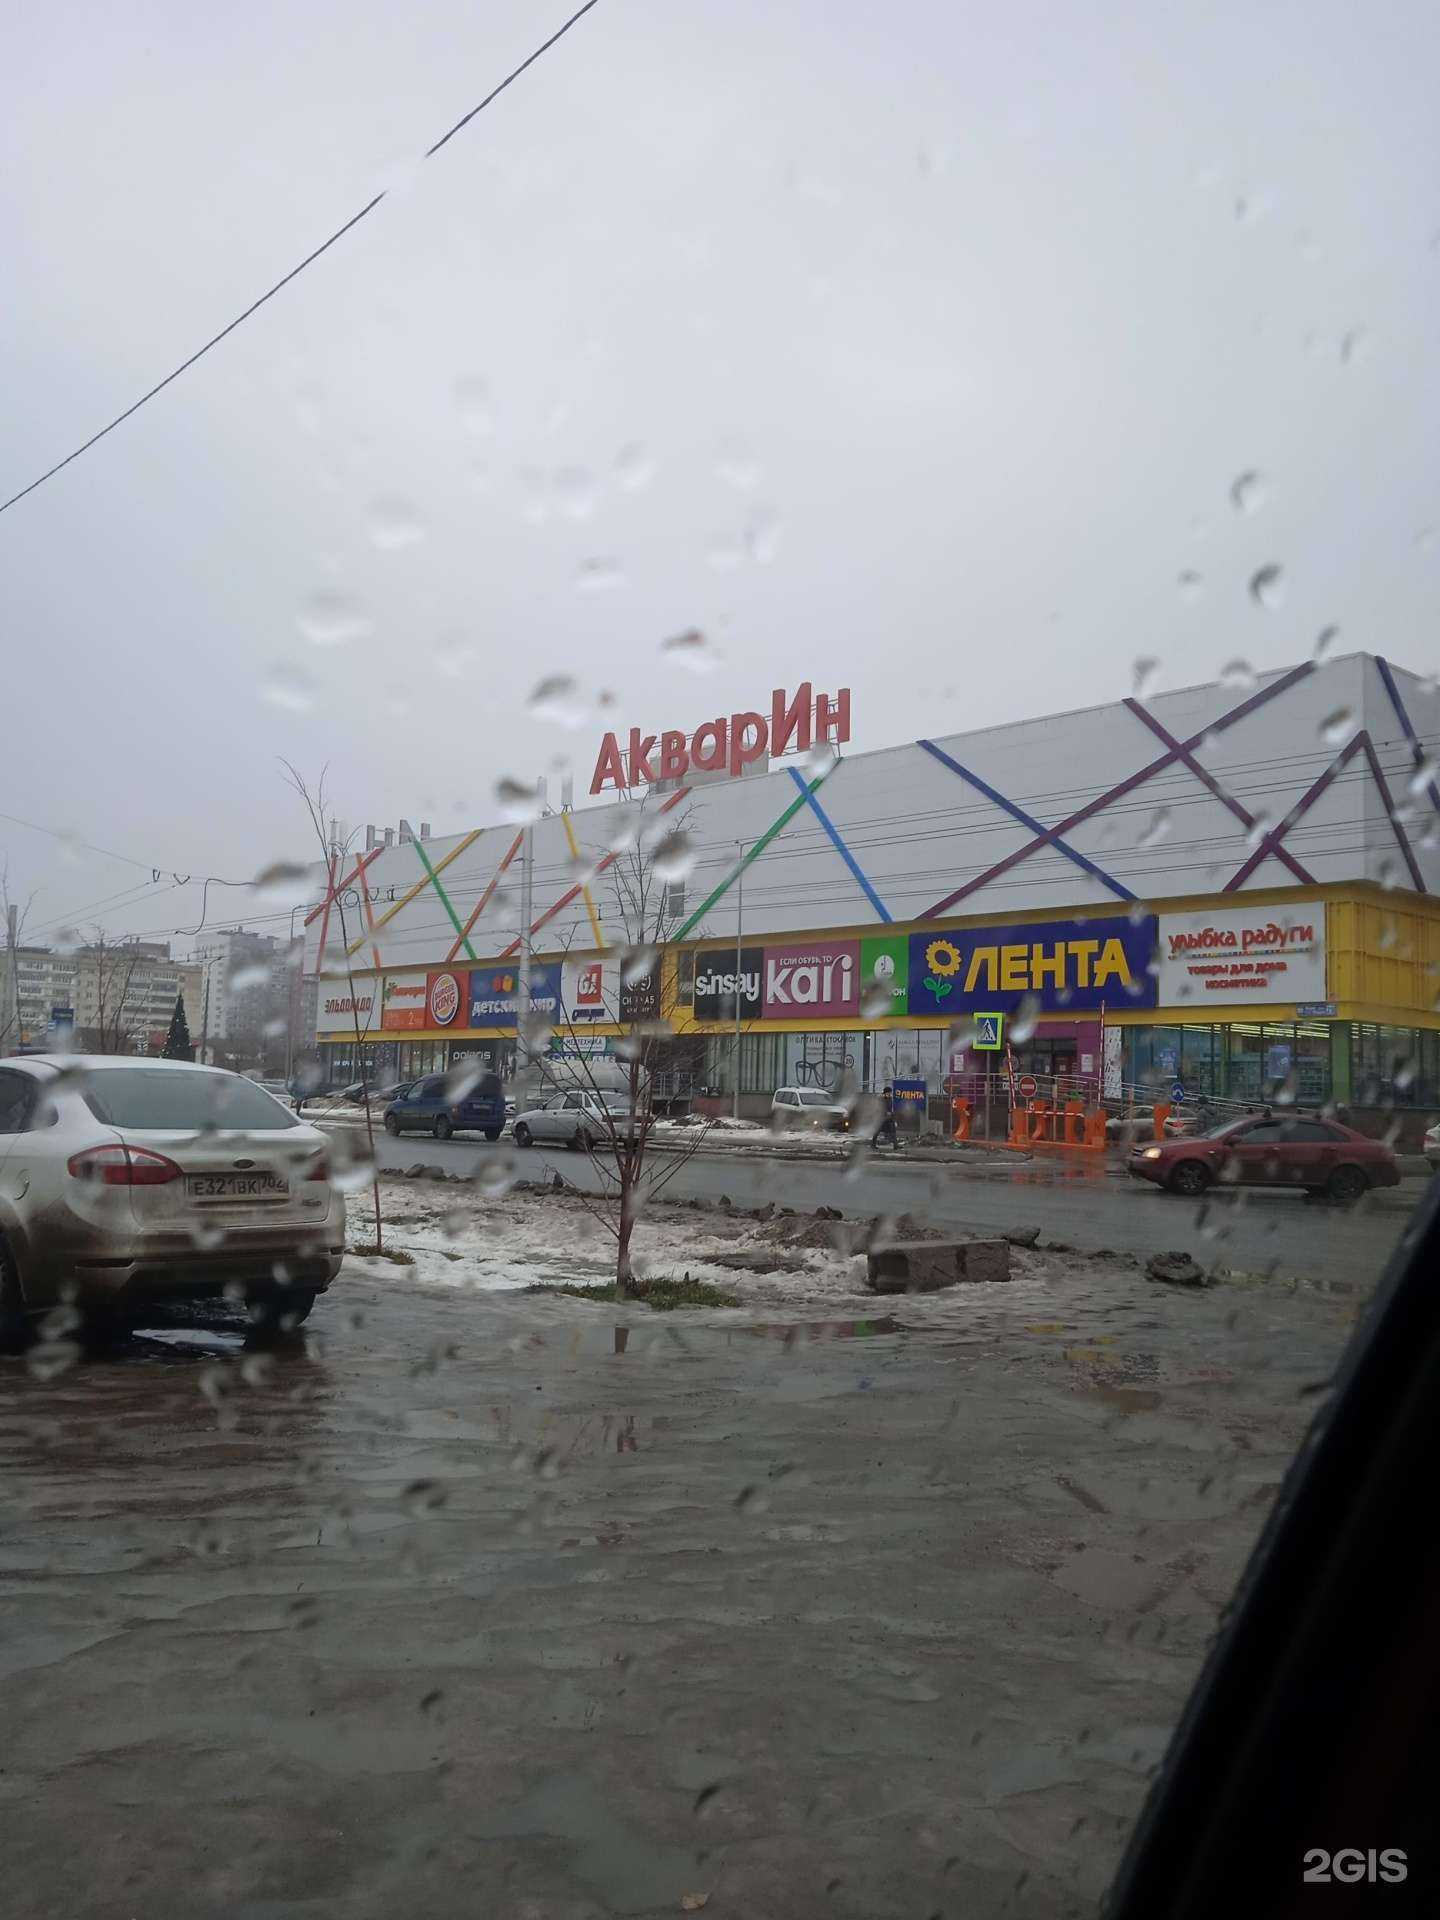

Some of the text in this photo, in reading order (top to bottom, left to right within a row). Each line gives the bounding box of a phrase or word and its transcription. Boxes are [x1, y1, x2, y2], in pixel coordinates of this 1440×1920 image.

[1168, 923, 1313, 953] улыбка радуги
[696, 969, 760, 1001] sinsay
[766, 954, 853, 1004] kari
[964, 939, 1131, 992] ЛЕНТА
